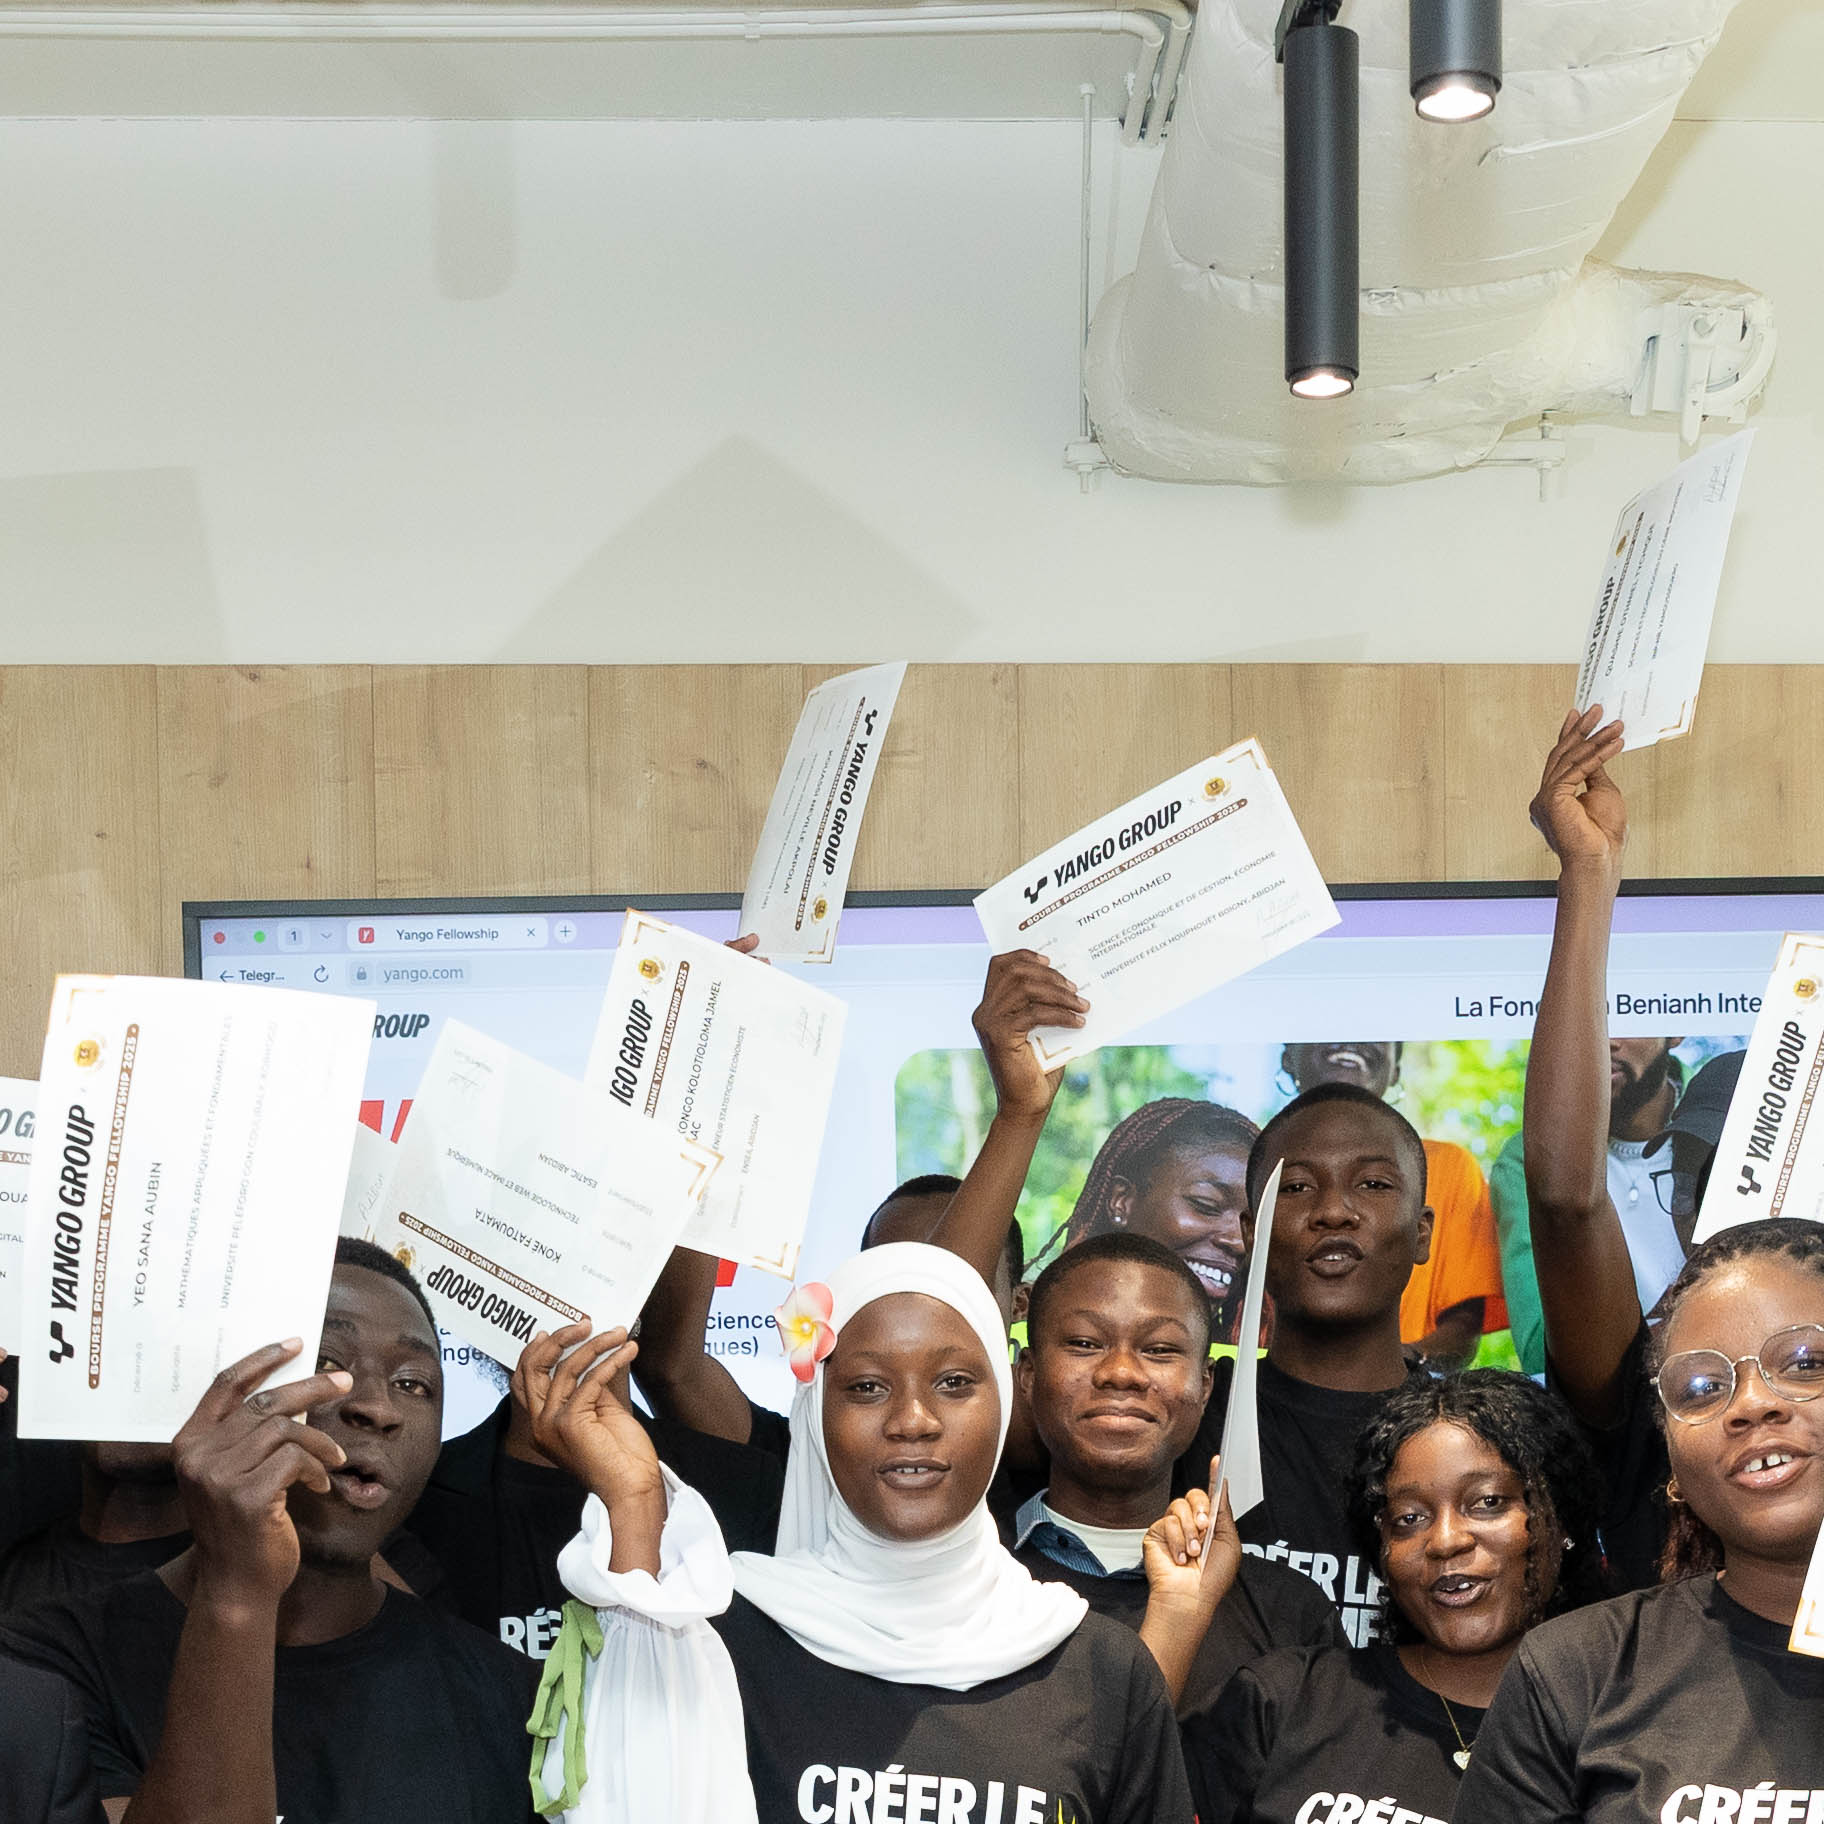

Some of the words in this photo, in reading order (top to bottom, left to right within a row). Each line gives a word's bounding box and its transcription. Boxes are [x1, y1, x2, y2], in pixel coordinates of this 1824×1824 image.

[1593, 576, 1616, 640] GROUP
[839, 742, 868, 805] YANGO
[822, 807, 847, 875] GROUP
[1053, 837, 1115, 887] YANGO
[1118, 800, 1181, 850] GROUP
[1075, 905, 1110, 926] TINTO
[1111, 872, 1171, 908] MOHAMED
[1251, 878, 1285, 900] ABIDJAN
[395, 928, 433, 941] Yango
[436, 926, 500, 941] Fellowship
[382, 966, 465, 984] yango.com
[1454, 995, 1484, 1019] La
[1615, 992, 1713, 1015] Benianh
[122, 1035, 138, 1069] 2025
[618, 998, 652, 1068] GROUP
[686, 1017, 712, 1094] KOLOTIOLOMA
[705, 981, 721, 1015] JAMEL
[1745, 1091, 1786, 1162] YANGO
[1767, 1020, 1806, 1091] GROUP
[108, 1071, 132, 1162] FELLOWSHIP
[58, 1104, 94, 1207] GROUP
[537, 1152, 569, 1173] ABIDJAN
[101, 1164, 118, 1216] YANGO
[144, 1162, 161, 1215] AUBIN
[504, 1180, 514, 1189] ET
[513, 1184, 530, 1198] WEB
[403, 1213, 424, 1231] 2025
[475, 1208, 532, 1247] FATOUMATA
[530, 1192, 579, 1224] TECHNOLOGIE
[50, 1211, 82, 1311] YANGO
[136, 1220, 153, 1266] SANA
[421, 1224, 472, 1258] FELLOWSHIP
[468, 1251, 498, 1273] YANGO
[92, 1218, 111, 1312] PROGRAMME
[426, 1264, 484, 1311] GROUP
[495, 1266, 548, 1302] PROGRAMME
[133, 1272, 146, 1306] YEO
[545, 1294, 583, 1322] BOURSE
[480, 1293, 537, 1345] YANGO
[88, 1315, 102, 1375] BOURSE
